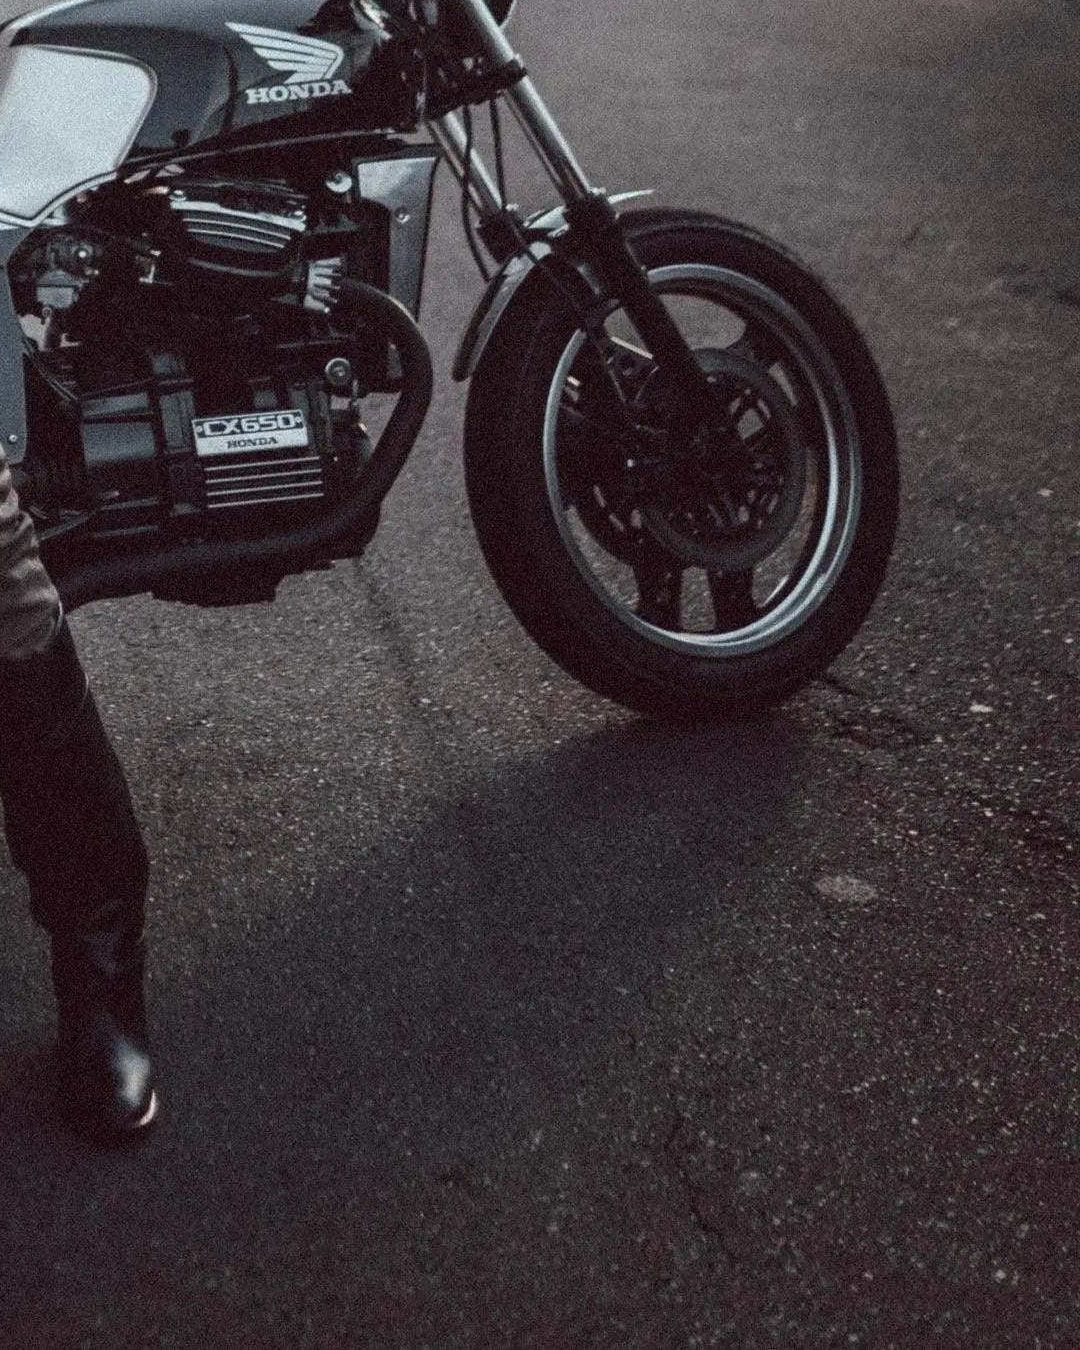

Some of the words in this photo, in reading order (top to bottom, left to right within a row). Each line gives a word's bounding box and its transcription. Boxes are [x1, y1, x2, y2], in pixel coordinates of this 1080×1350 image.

[245, 80, 352, 104] HONDA
[203, 414, 296, 436] CX650
[227, 437, 278, 448] HONDA
